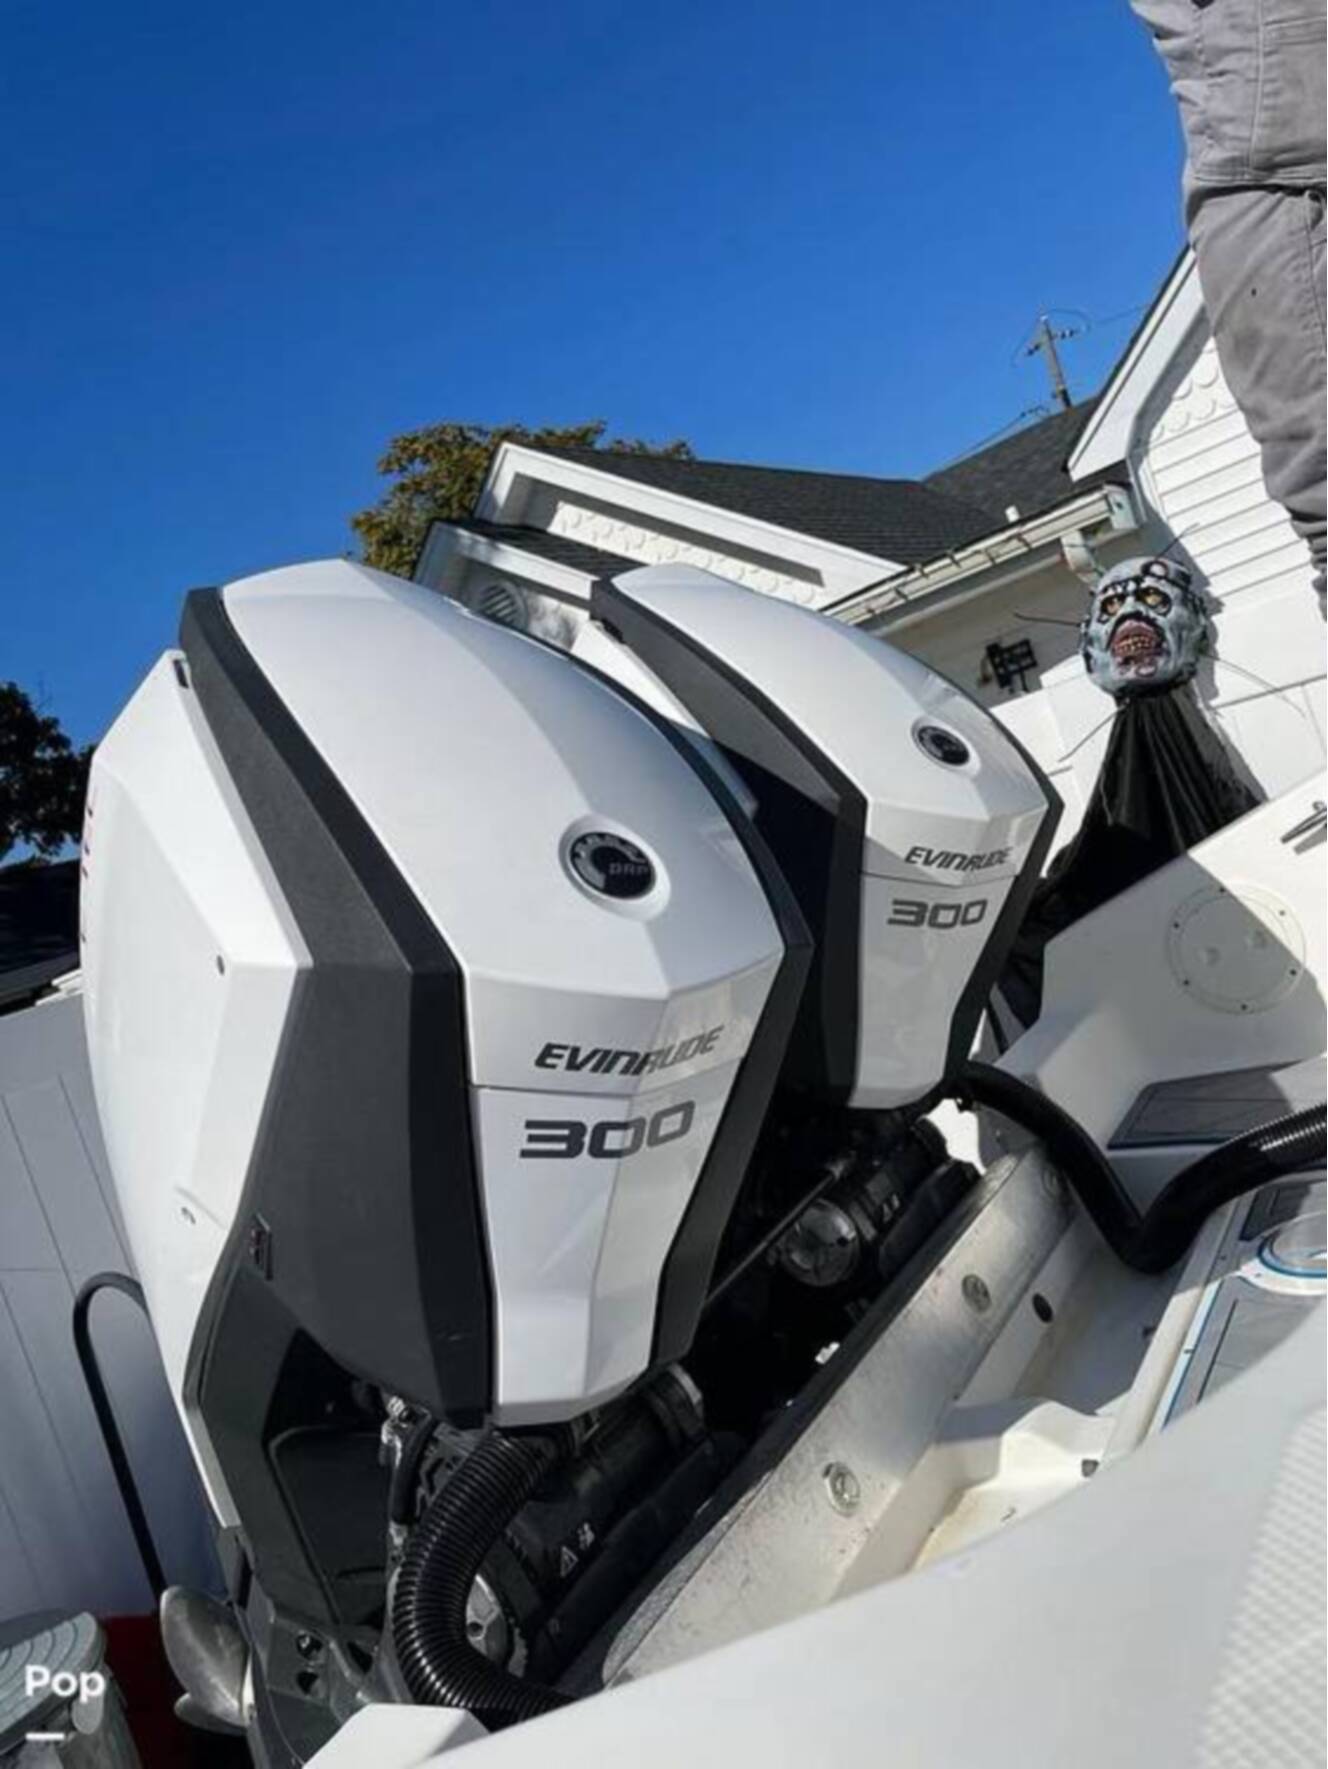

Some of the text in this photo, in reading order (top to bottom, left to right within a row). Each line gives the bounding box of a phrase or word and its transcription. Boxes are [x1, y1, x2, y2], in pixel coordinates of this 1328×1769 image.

[904, 846, 1014, 872] EVINRUDE
[886, 899, 988, 929] 300
[535, 1024, 725, 1076] EVINRUDE
[519, 1100, 696, 1159] 300
